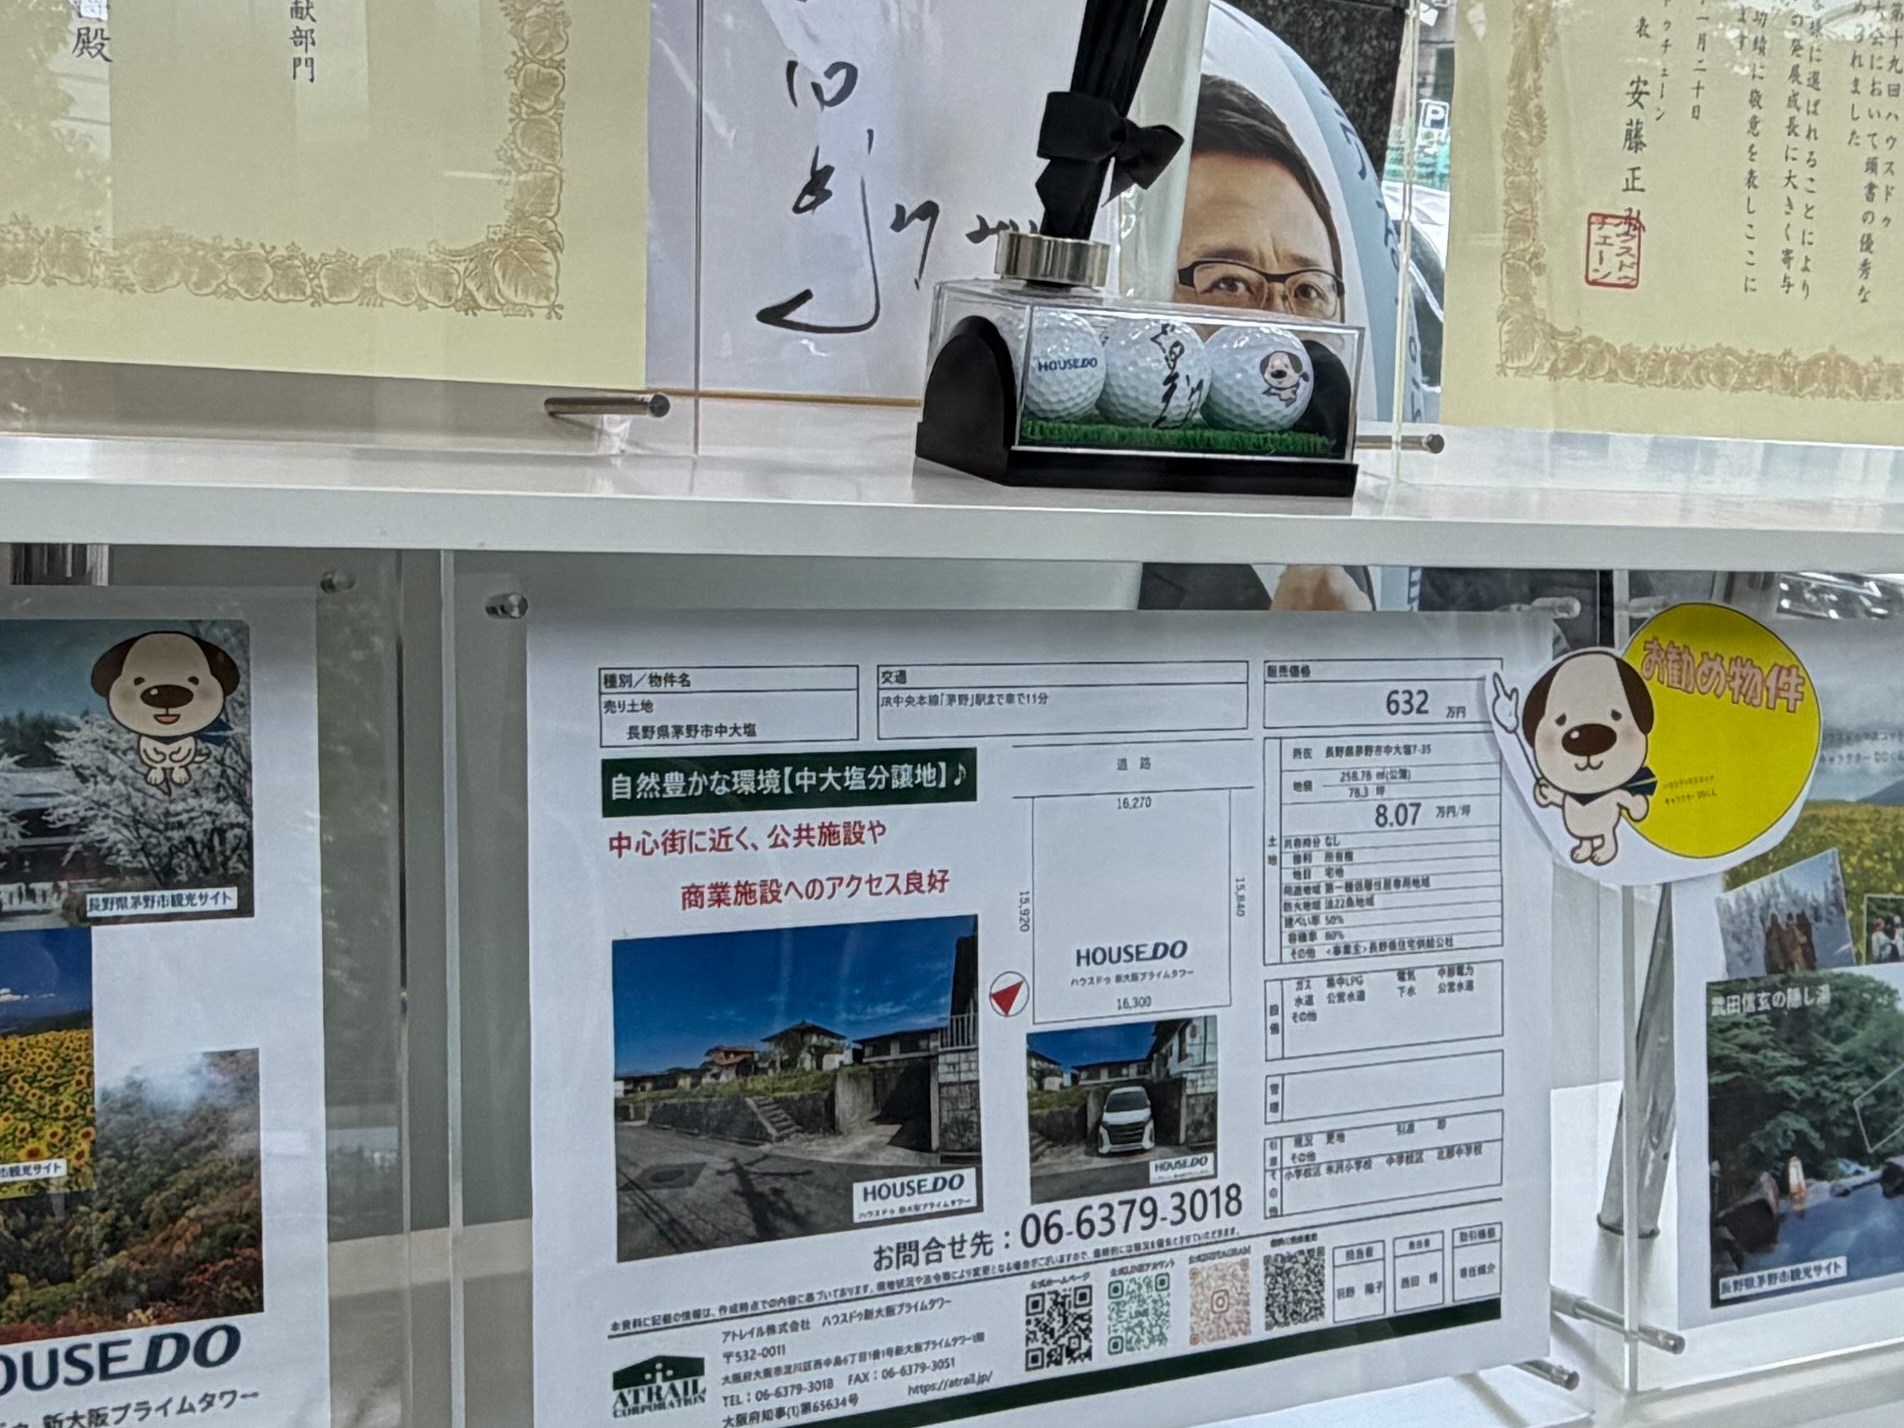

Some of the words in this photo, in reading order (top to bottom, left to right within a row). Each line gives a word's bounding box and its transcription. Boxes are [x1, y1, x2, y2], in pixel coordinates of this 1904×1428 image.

[1640, 634, 1806, 714] お勧め物件
[602, 698, 655, 715] 売り土地
[1385, 688, 1430, 717] 632
[625, 722, 758, 741] 長野県茅野市中大塩
[1116, 796, 1152, 811] 16,270
[1374, 801, 1423, 829] 8.07
[608, 819, 887, 859] 中心街に近く、公共施設や
[680, 867, 950, 911] 商業施設へのアクセス良好
[1018, 889, 1031, 933] 15,920
[721, 1317, 812, 1344] アトレイル株式会社
